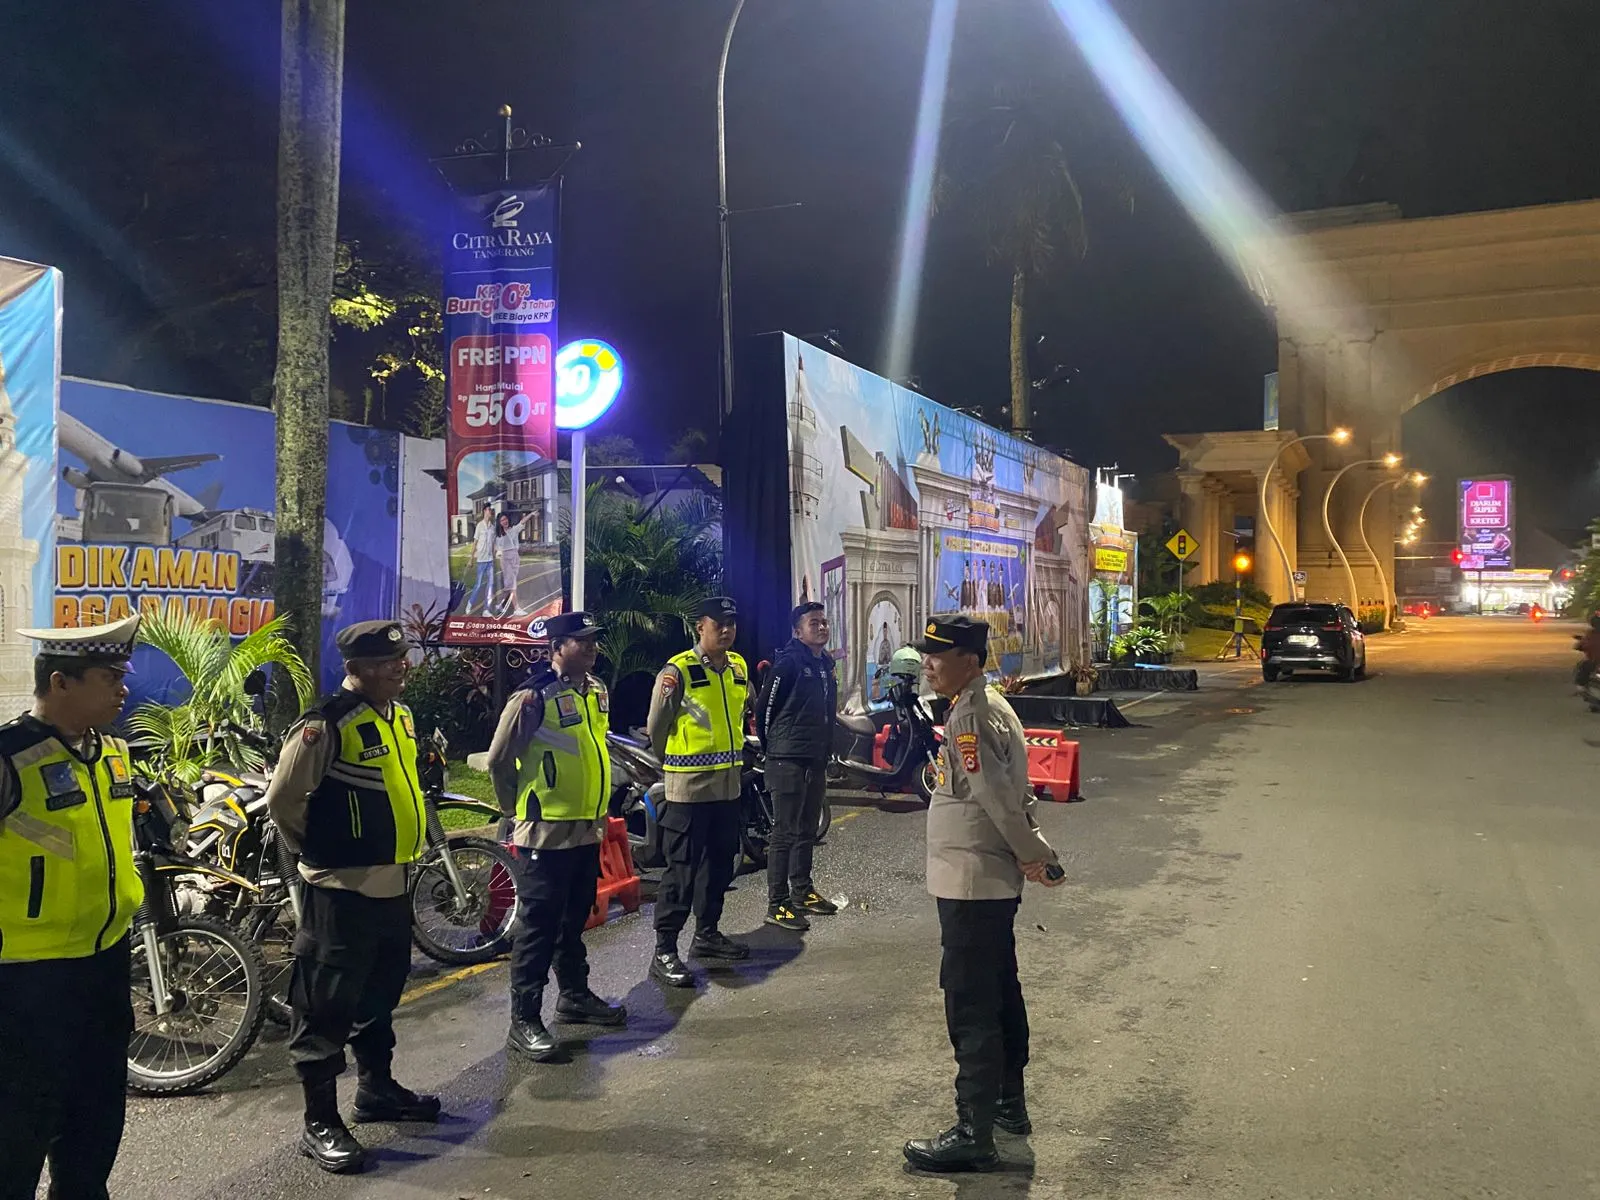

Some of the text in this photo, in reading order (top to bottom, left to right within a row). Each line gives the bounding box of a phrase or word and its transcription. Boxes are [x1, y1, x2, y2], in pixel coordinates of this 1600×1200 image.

[473, 248, 534, 259] TANERANG
[529, 300, 556, 310] Tahun
[509, 312, 532, 322] Biaya
[458, 345, 546, 367] FREE PPN
[466, 393, 531, 428] 550
[531, 402, 547, 416] JT
[56, 546, 237, 591] DIK AMAN
